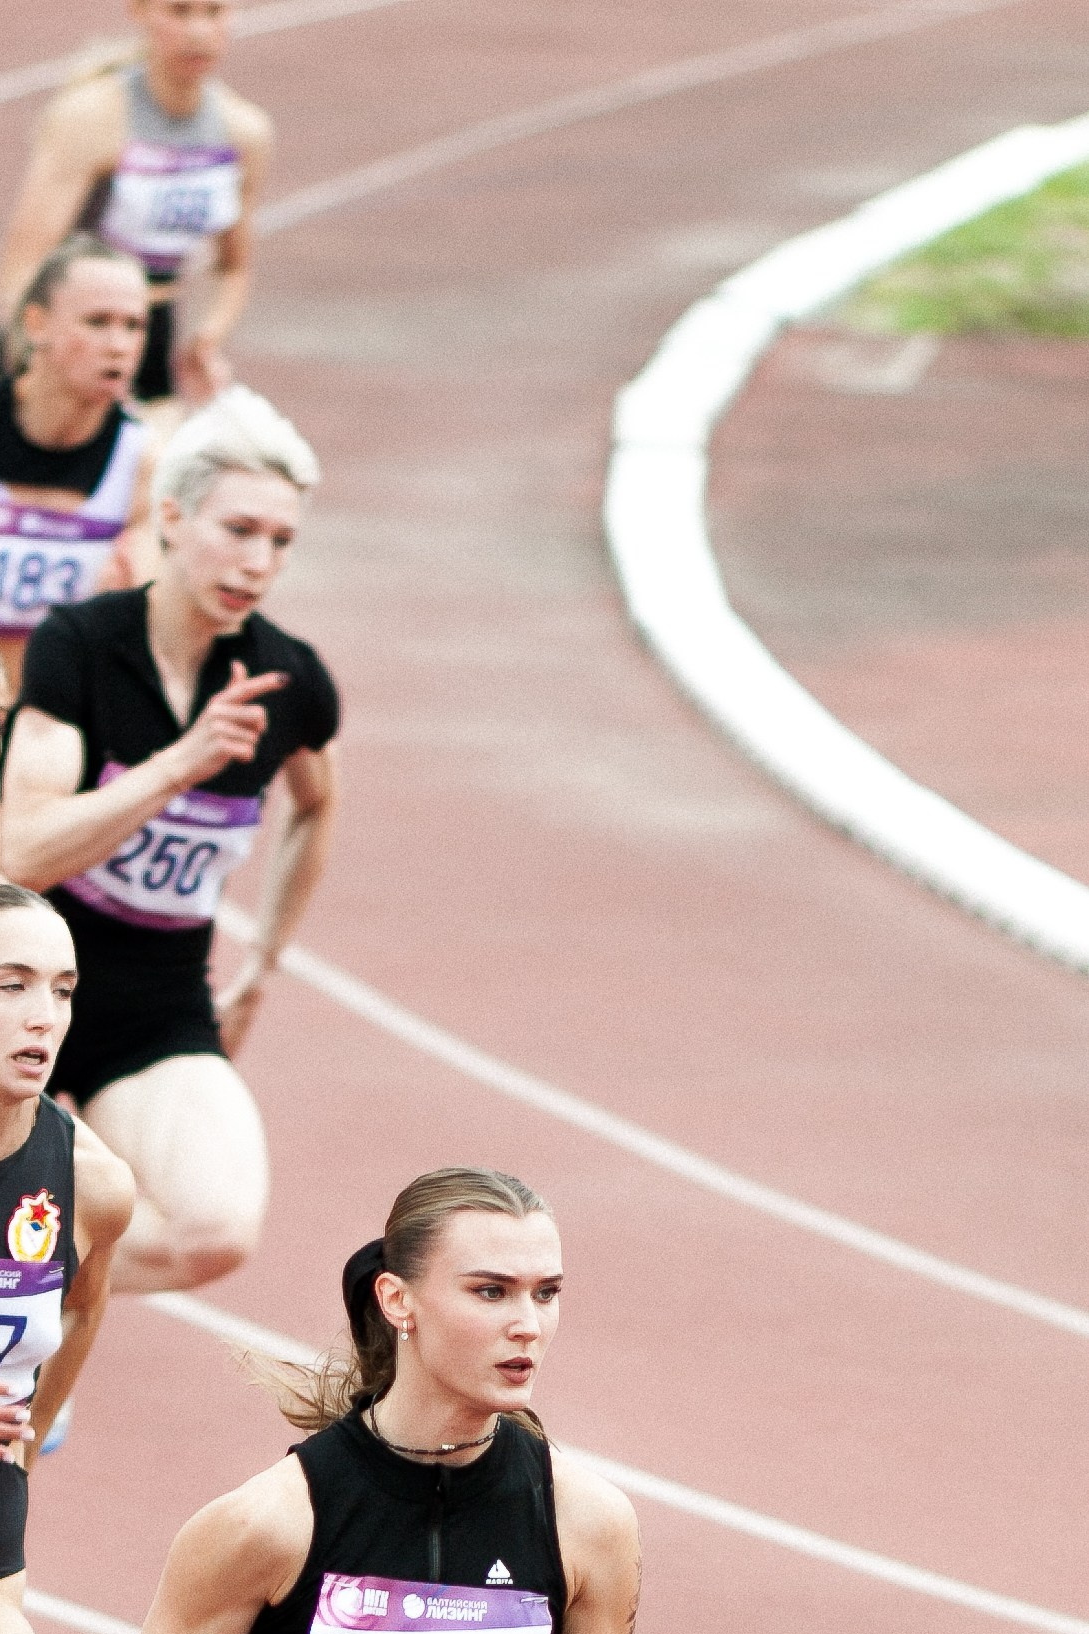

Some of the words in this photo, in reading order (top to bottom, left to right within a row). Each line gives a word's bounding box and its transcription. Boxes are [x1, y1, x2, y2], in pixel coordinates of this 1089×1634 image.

[106, 827, 219, 896] 250
[427, 1597, 488, 1609] БАЛТИЙСКИЙ
[426, 1605, 488, 1622] ЛИЗИНГ
